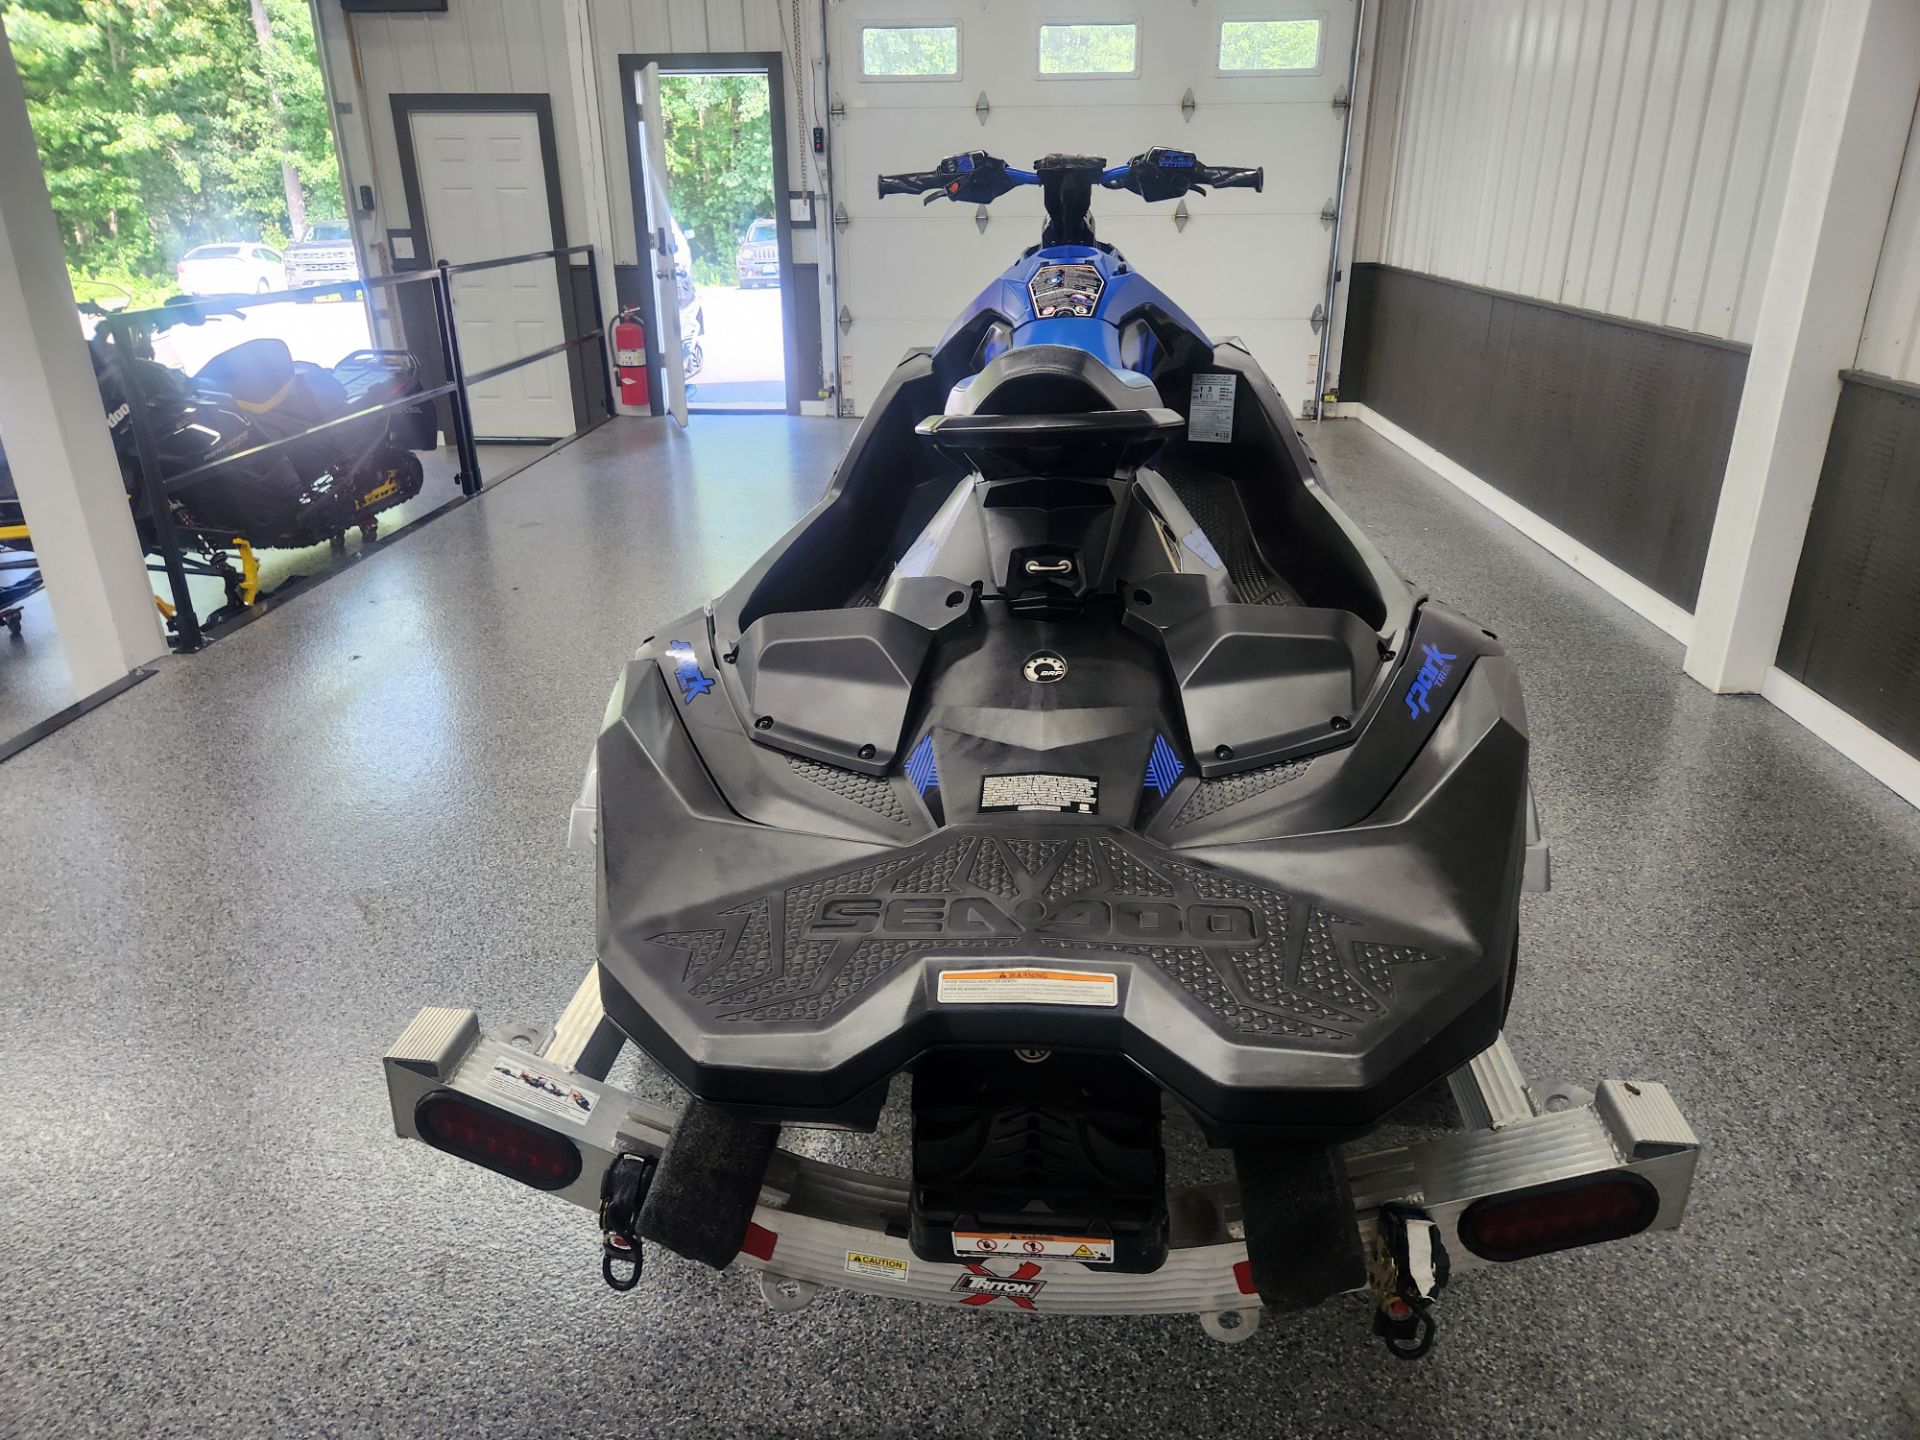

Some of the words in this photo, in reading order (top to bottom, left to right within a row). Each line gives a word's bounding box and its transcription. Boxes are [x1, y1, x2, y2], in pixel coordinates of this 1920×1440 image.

[1404, 642, 1457, 720] spark
[1008, 971, 1049, 980] WARNING
[862, 1256, 903, 1269] CAUTION
[968, 1277, 1034, 1294] TRITON
